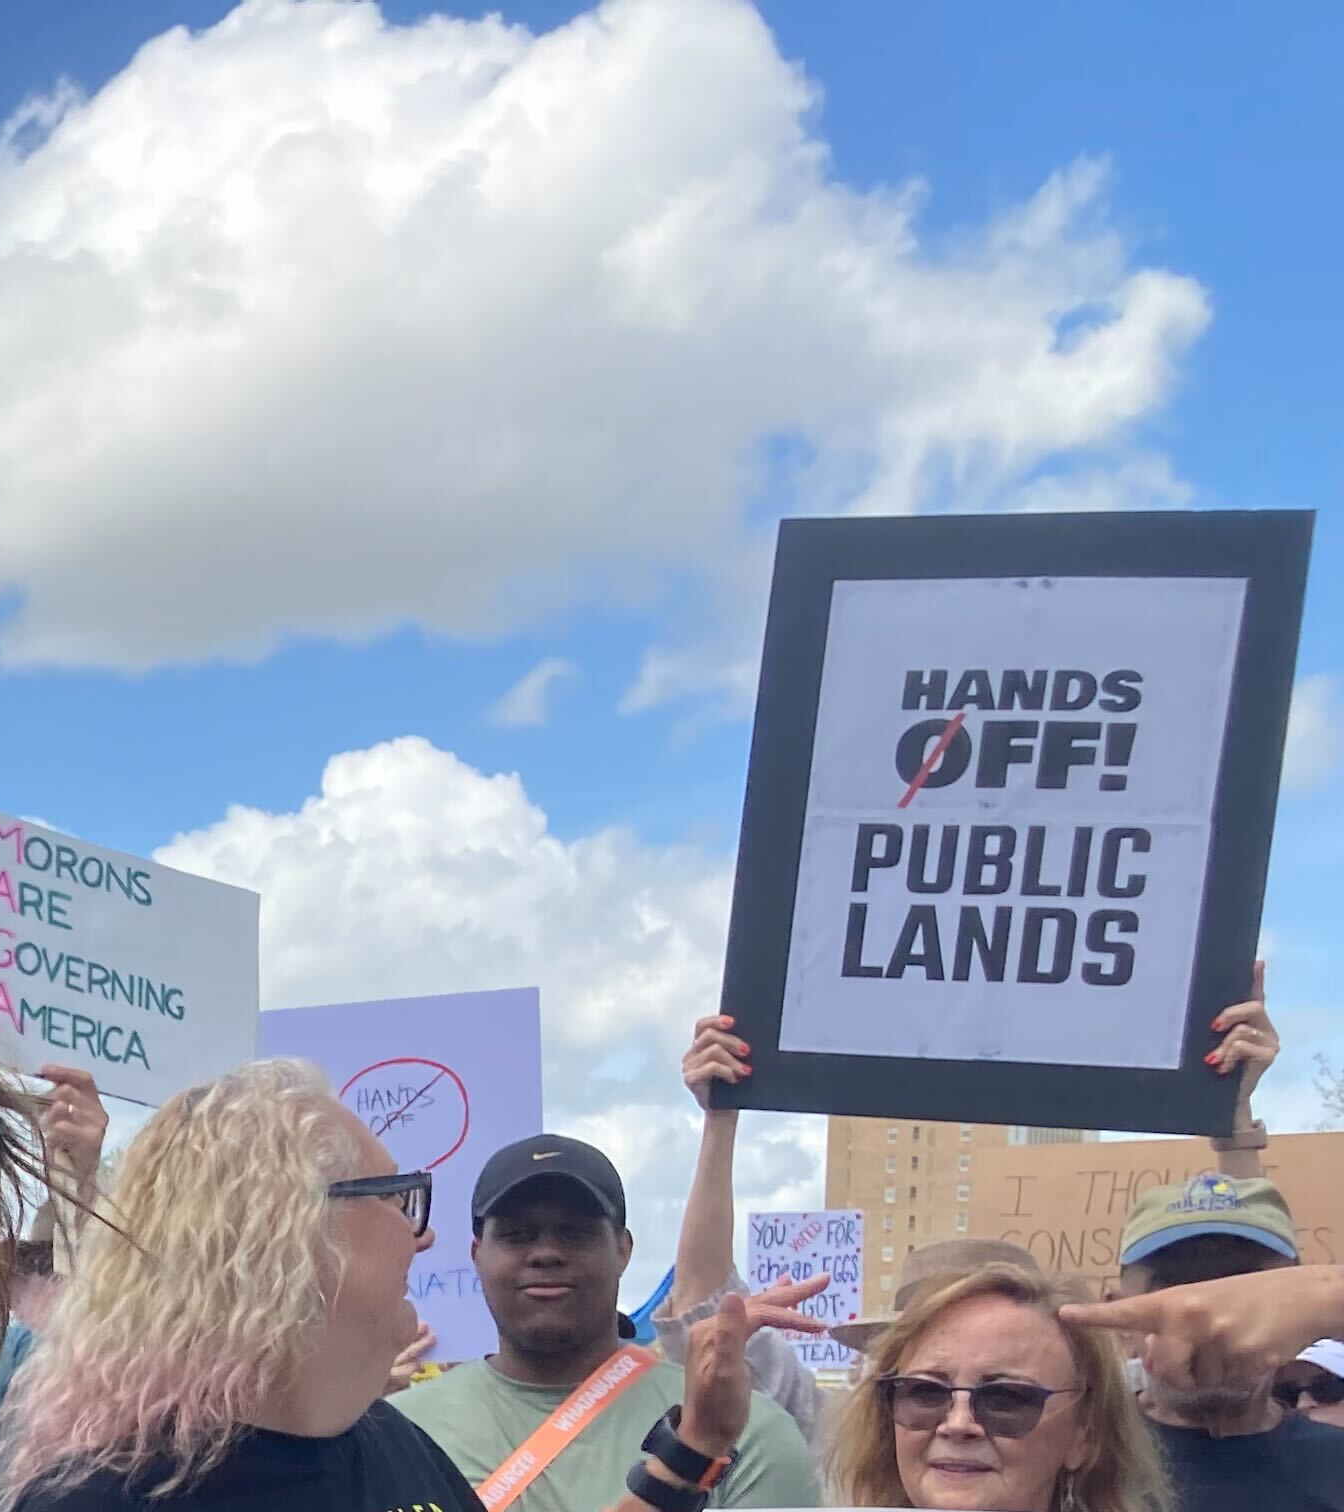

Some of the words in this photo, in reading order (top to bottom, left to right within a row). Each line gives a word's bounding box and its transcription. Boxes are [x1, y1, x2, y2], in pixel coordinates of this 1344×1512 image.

[901, 669, 1144, 713] HANDS
[895, 719, 1138, 792] OFF!
[850, 823, 1152, 899] PUBLIC
[840, 903, 1139, 987] LANDS
[357, 1084, 435, 1113] HANDS
[369, 1111, 414, 1135] OFF
[752, 1221, 786, 1249] YOU
[827, 1220, 855, 1245] FOR
[553, 1355, 642, 1431] WHATABURGER
